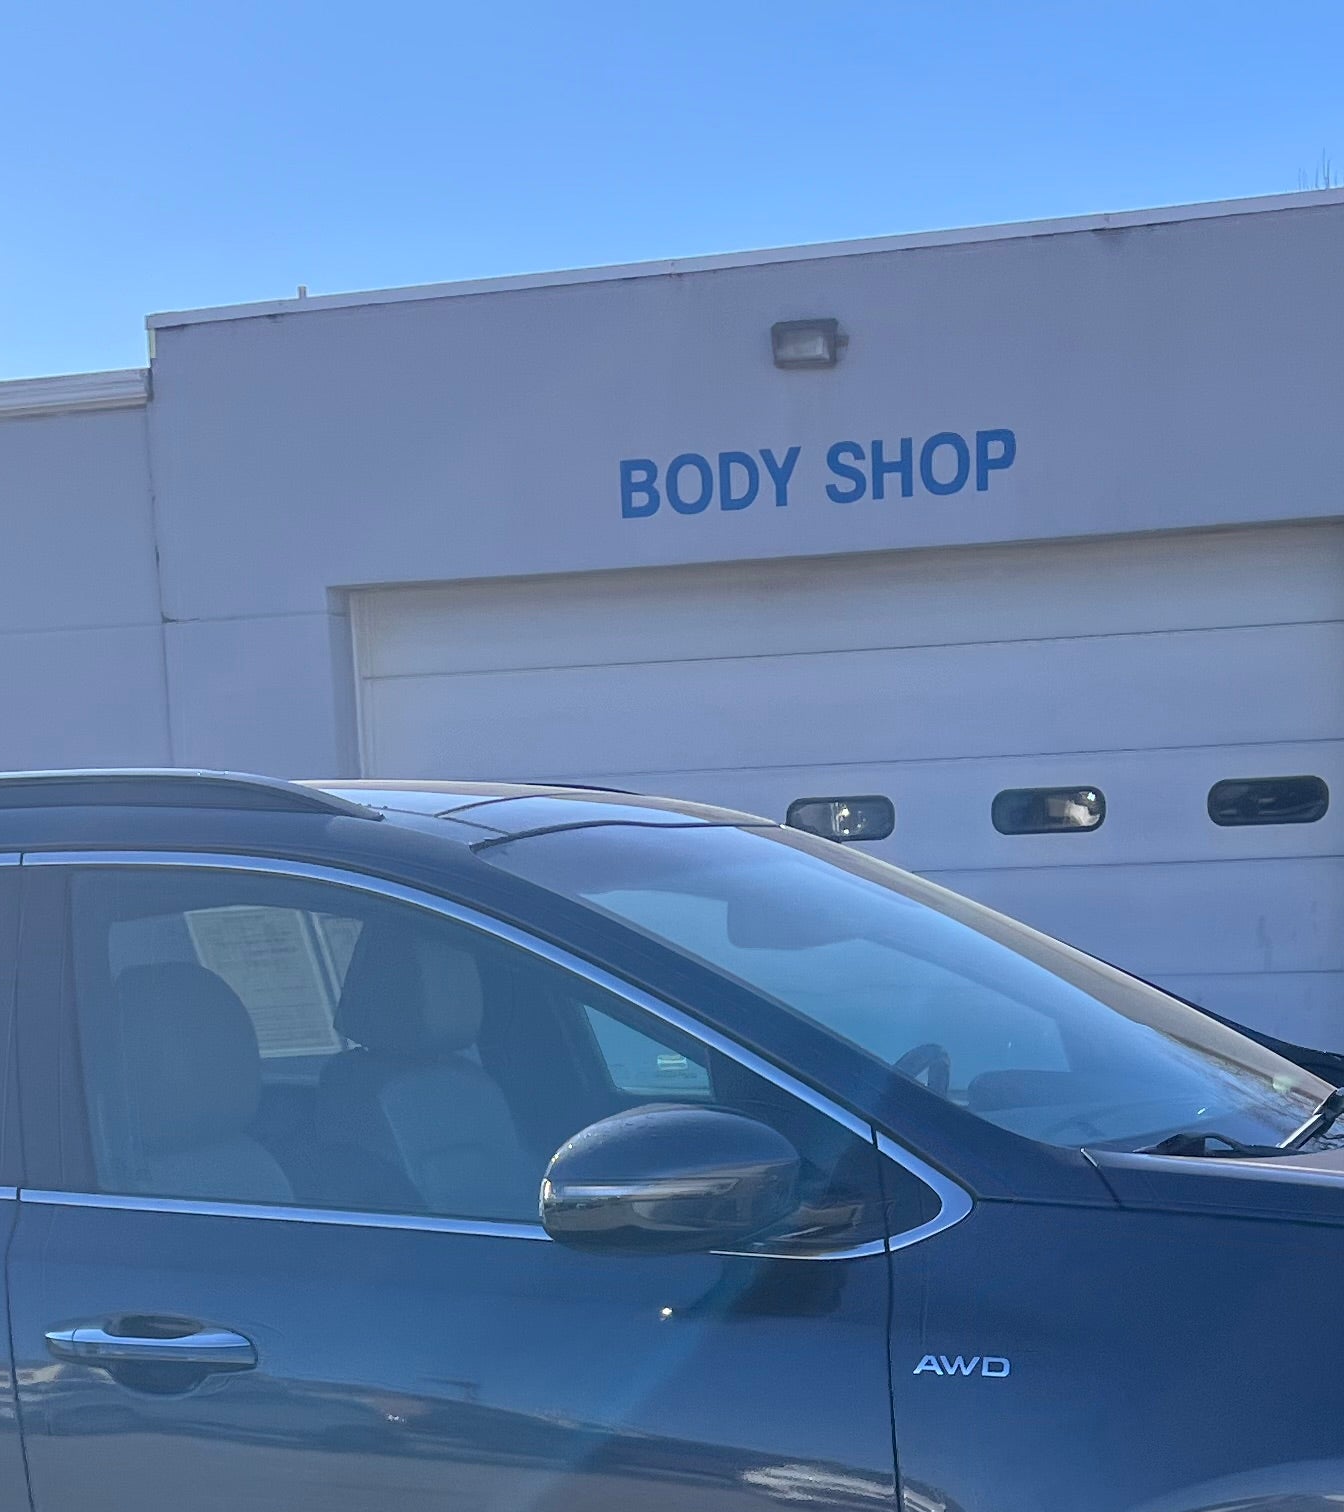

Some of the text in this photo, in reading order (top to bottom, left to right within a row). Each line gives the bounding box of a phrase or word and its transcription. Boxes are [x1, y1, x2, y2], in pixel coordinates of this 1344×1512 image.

[619, 428, 1017, 519] BODY SHOP
[912, 1354, 1011, 1378] AWD
